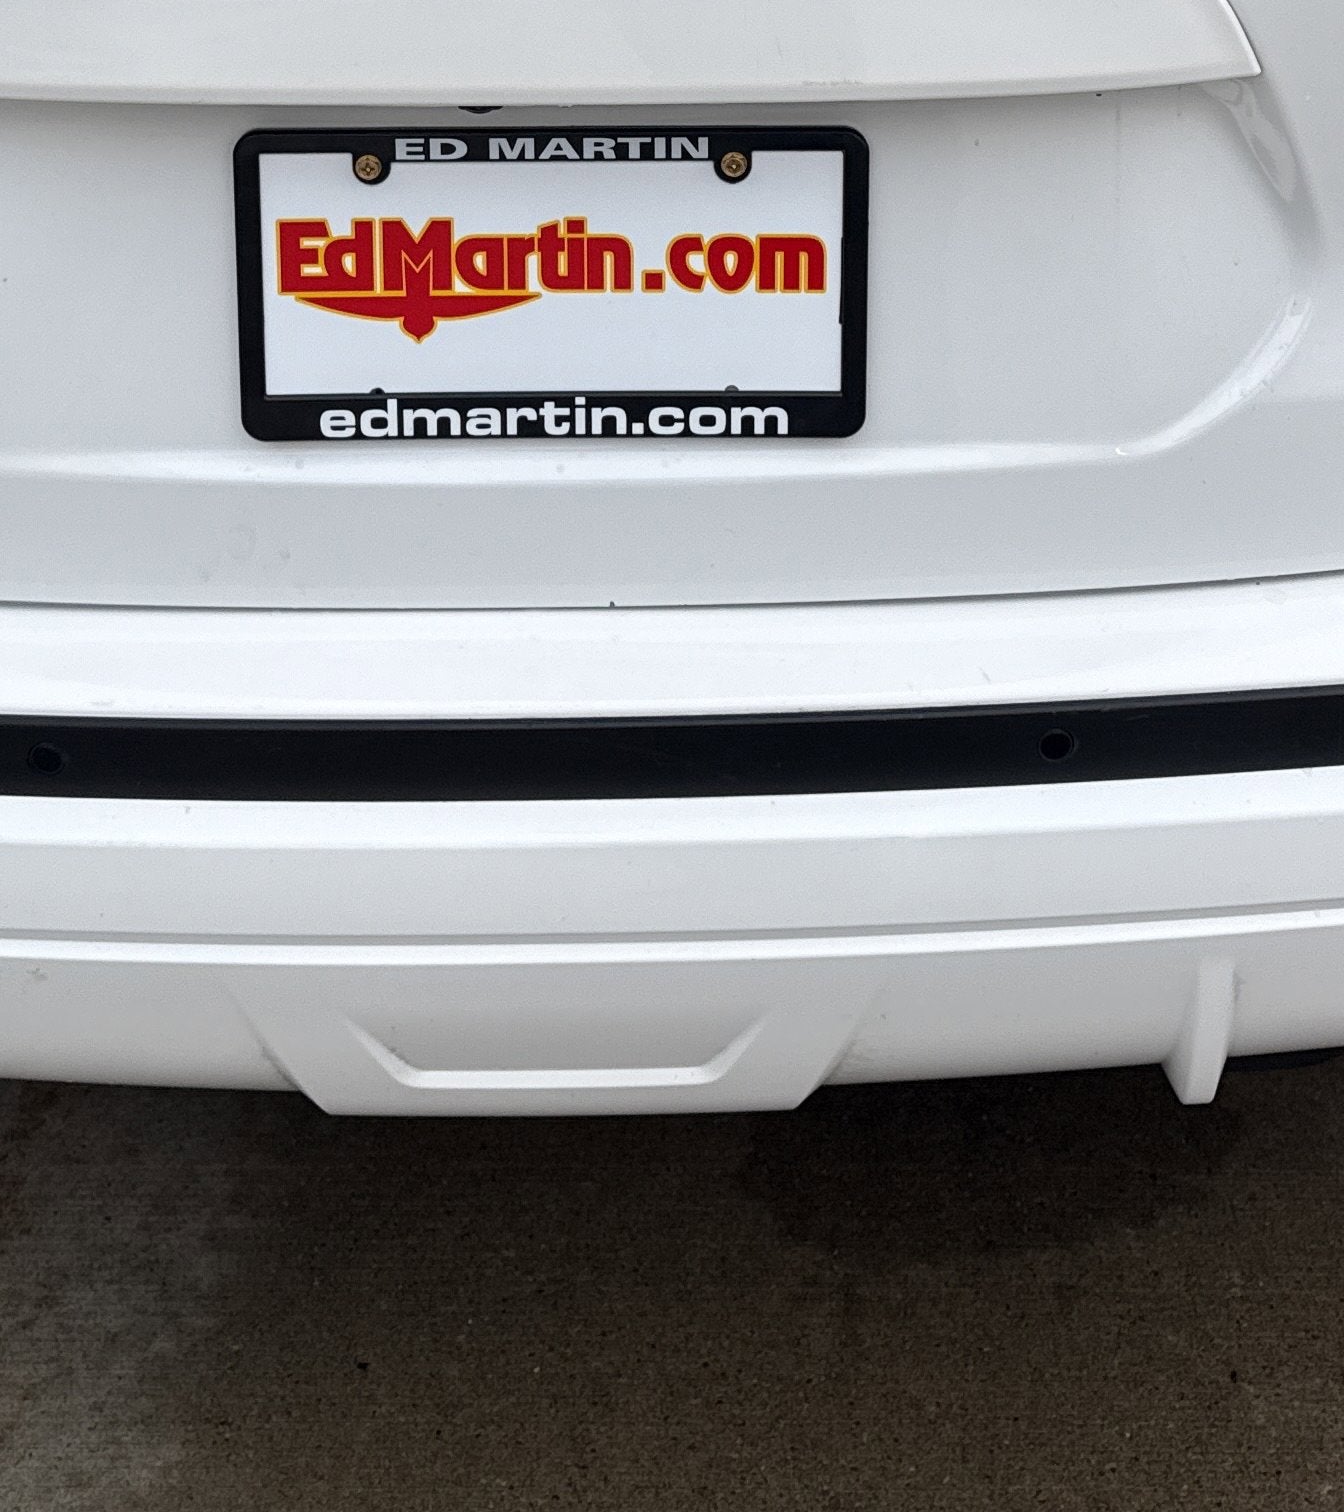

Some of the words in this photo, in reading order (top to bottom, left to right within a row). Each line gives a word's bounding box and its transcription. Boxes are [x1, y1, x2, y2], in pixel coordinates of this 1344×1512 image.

[394, 137, 468, 161] ED
[488, 135, 711, 160] MARTIN
[319, 397, 790, 439] edmartin.com
